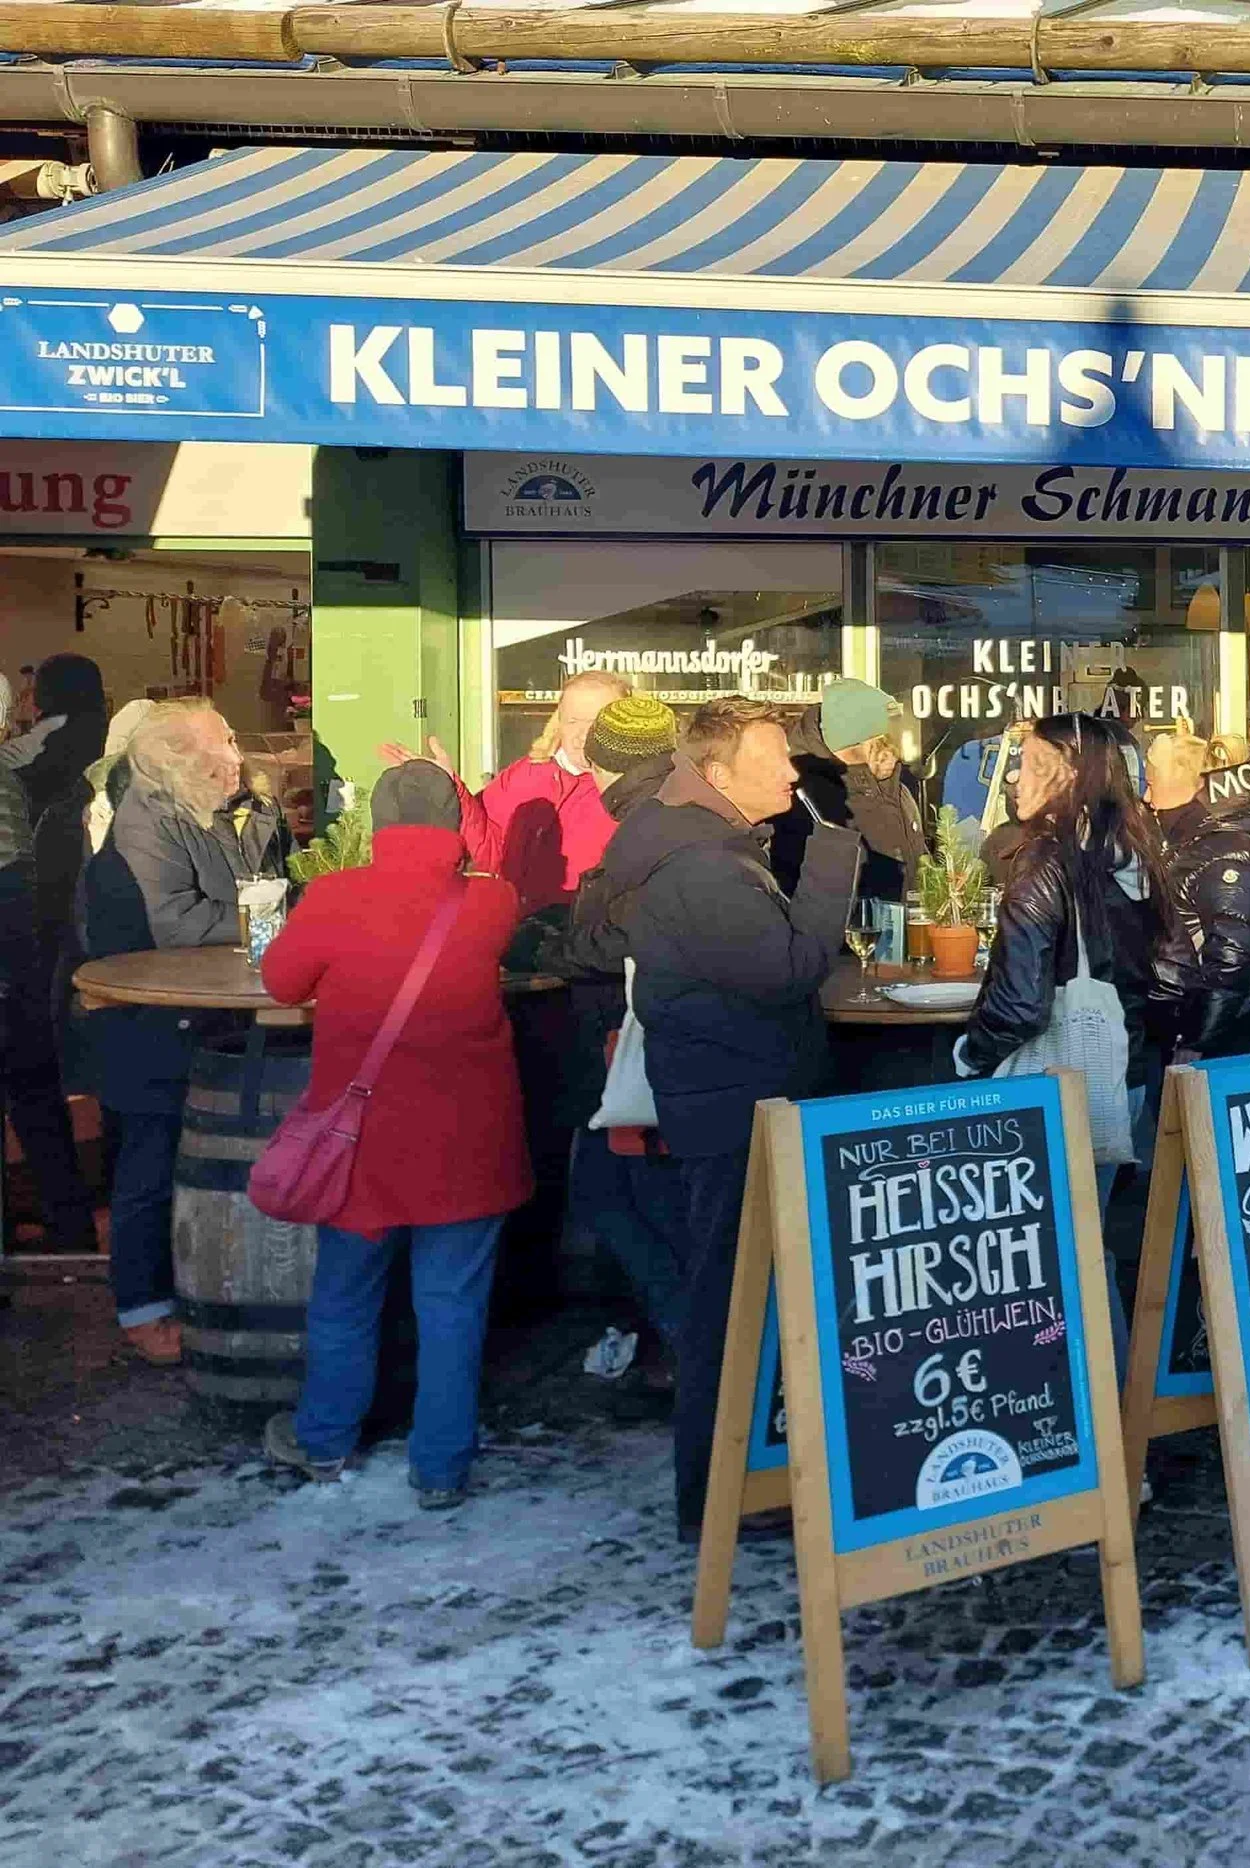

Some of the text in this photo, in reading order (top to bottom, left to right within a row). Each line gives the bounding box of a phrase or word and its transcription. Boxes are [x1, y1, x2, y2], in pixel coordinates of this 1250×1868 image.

[37, 341, 216, 364] LANDSHUTER
[329, 324, 788, 417] KLEINER
[67, 364, 187, 389] ZWICK'L
[501, 459, 596, 499] LANDSHUTER
[691, 462, 997, 520] Münchner
[505, 504, 592, 518] BRAUHAUS
[558, 637, 779, 692] Herrmannsdorfer
[973, 639, 1128, 673] KLEINER
[911, 682, 1191, 719] OCHS'NBATER
[871, 1093, 1001, 1121] DAS BIER FÜR HIER
[839, 1118, 1024, 1170] NUR BEI UNS
[849, 1222, 1047, 1324] HIRSCH
[990, 1382, 1055, 1418] Pfand
